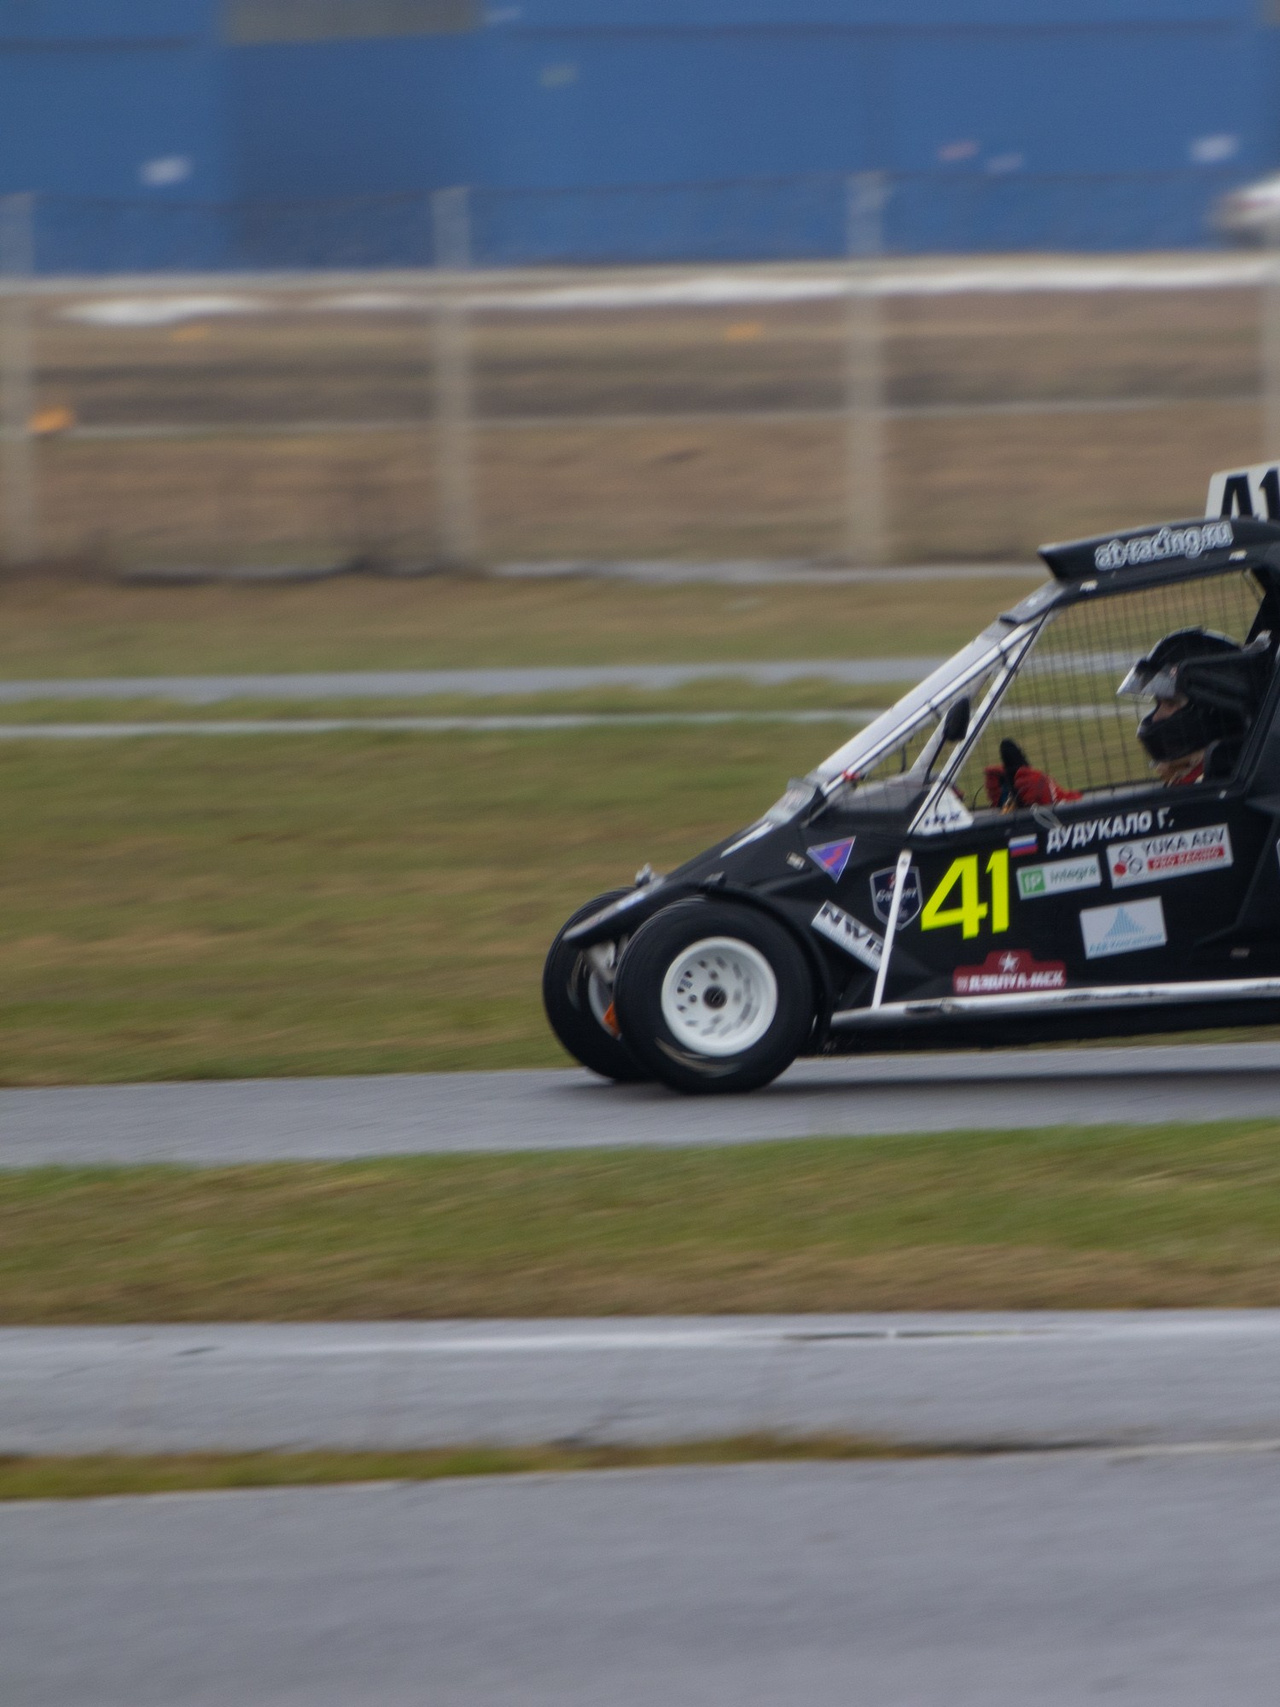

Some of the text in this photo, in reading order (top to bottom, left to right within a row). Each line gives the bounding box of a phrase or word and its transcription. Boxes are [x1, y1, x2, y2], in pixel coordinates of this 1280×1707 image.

[1046, 811, 1152, 854] ДУДУКАЛО
[1141, 833, 1188, 856] YUKA
[920, 849, 1009, 939] 41
